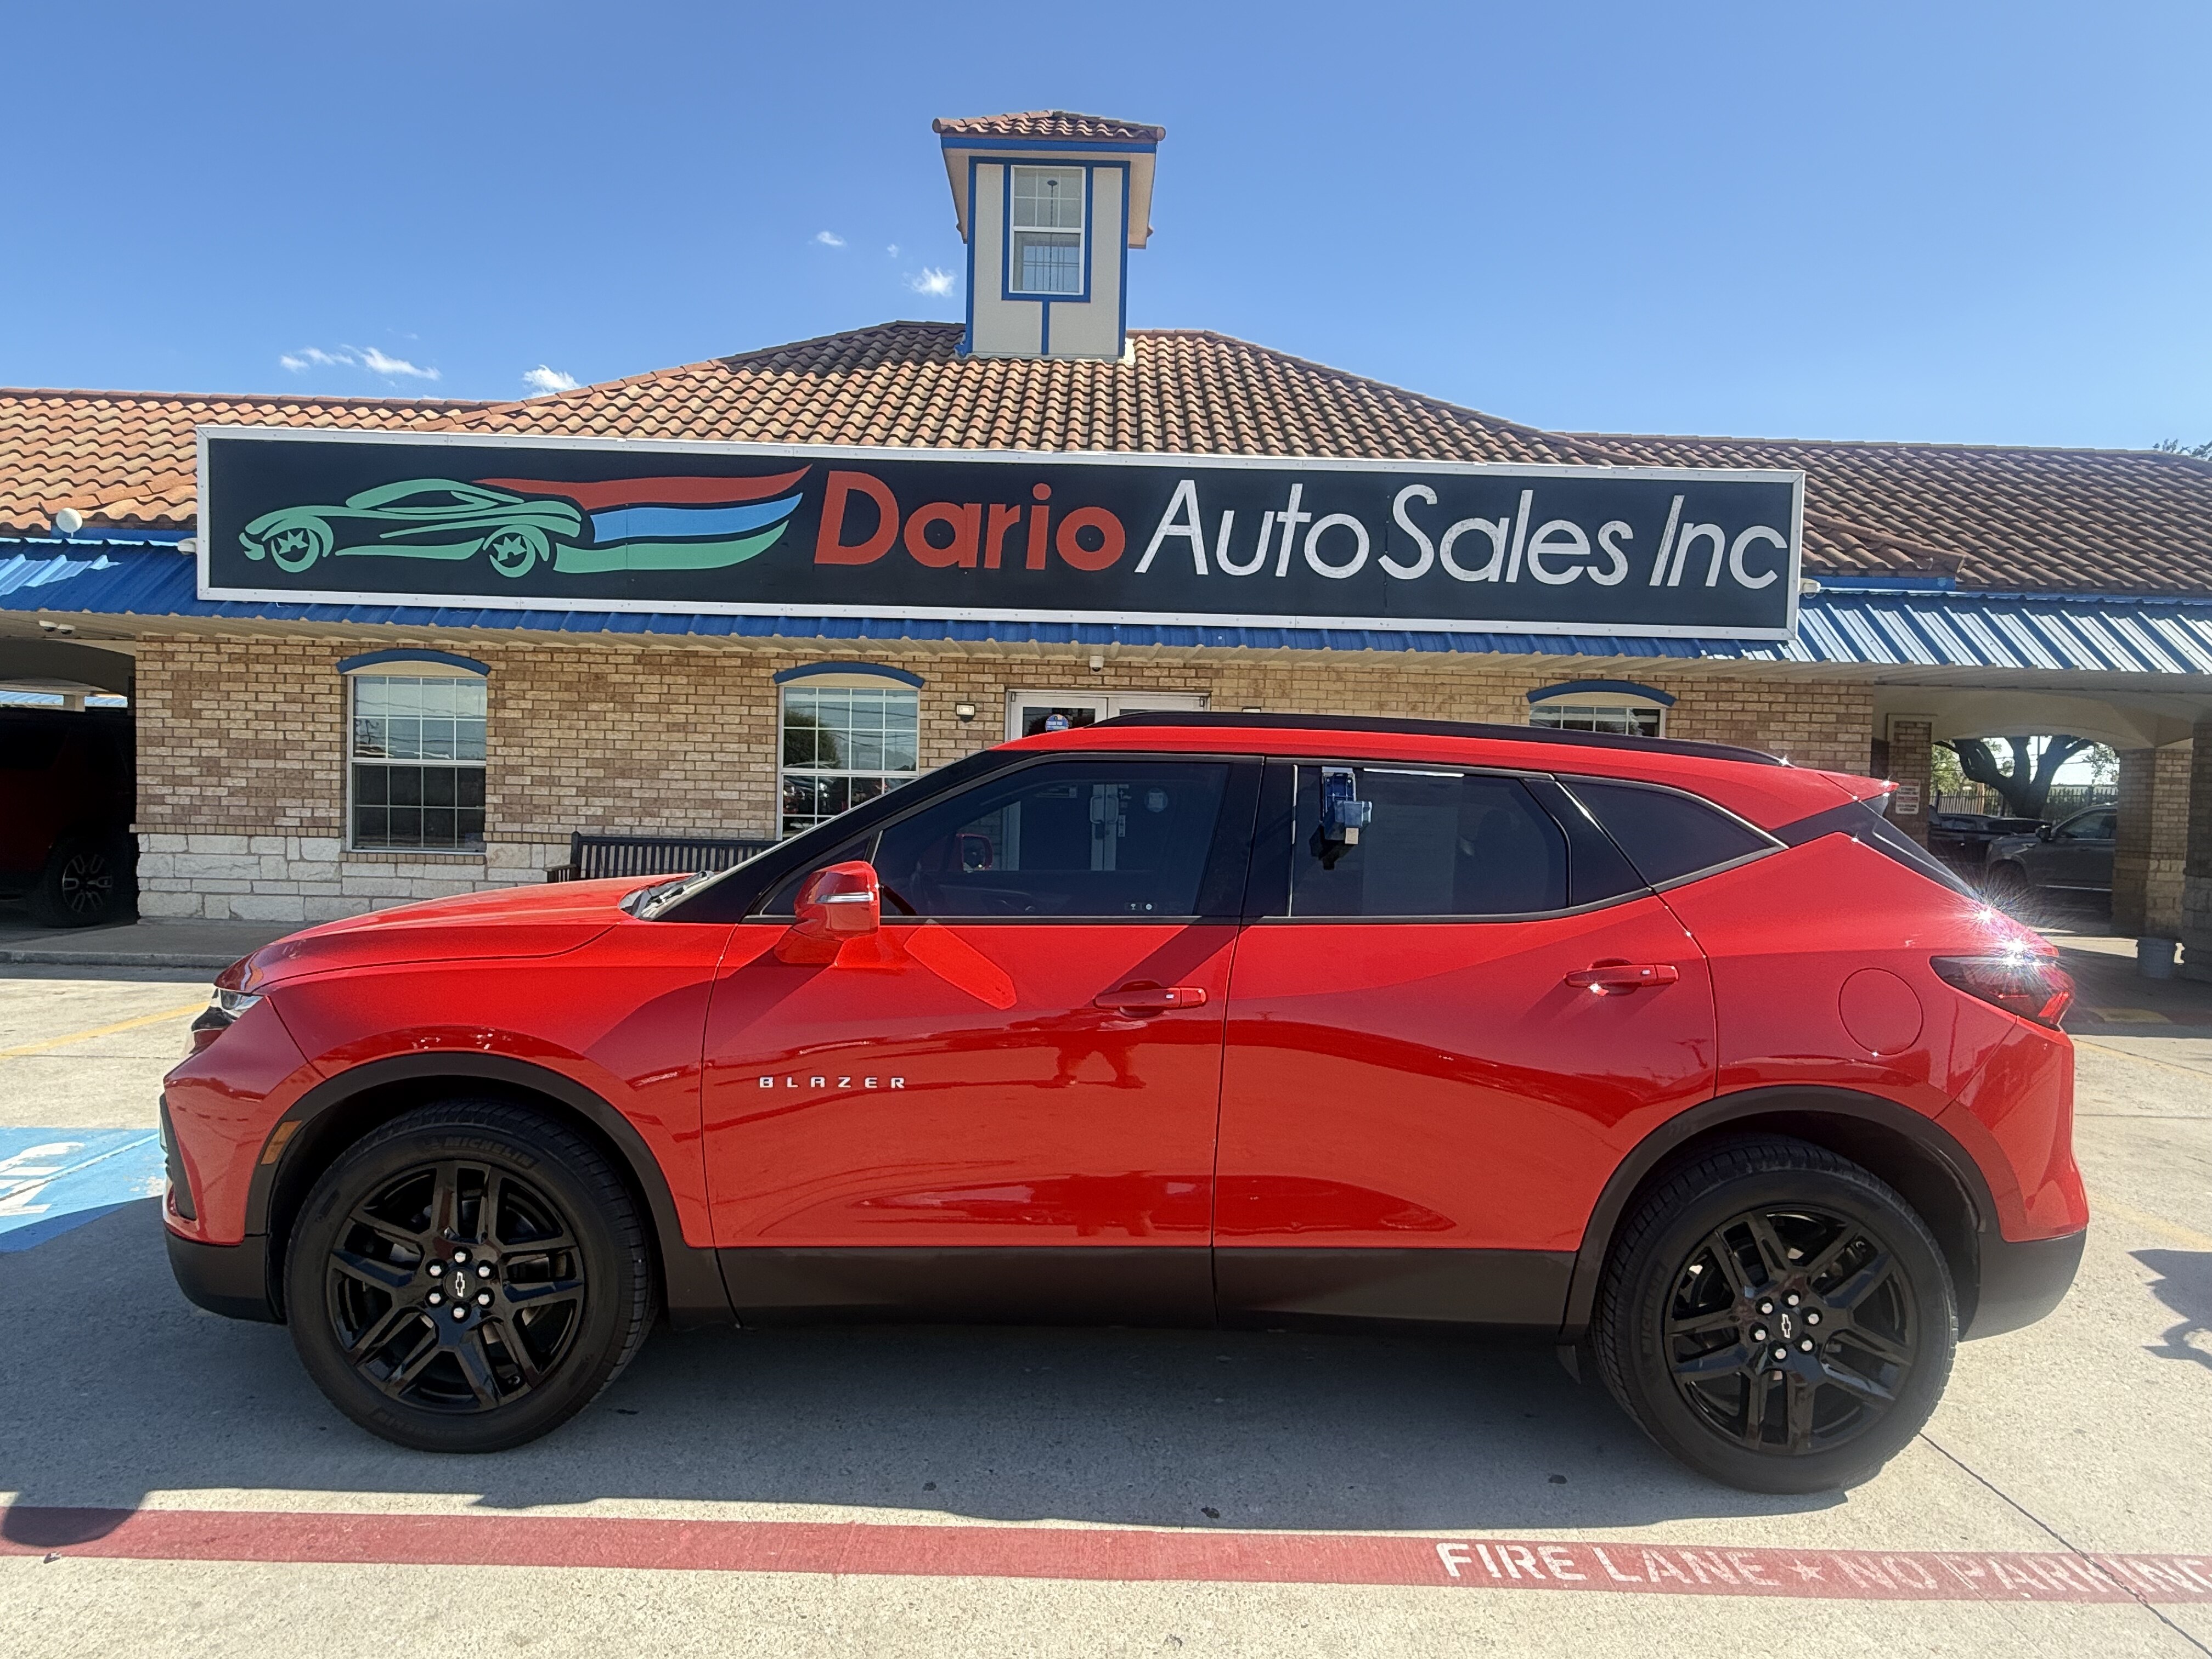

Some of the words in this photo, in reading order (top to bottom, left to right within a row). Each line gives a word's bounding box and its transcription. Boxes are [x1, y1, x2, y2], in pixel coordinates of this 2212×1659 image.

[814, 470, 1126, 571] Dario
[1135, 479, 1370, 579] Auto
[1378, 484, 1634, 585] Sales
[1649, 495, 1787, 589] Inc
[759, 1076, 905, 1089] BLAZER
[443, 1136, 535, 1167] MICHELIN
[1435, 1542, 1587, 1581] FIRE
[1592, 1547, 1781, 1586] LANE
[1827, 1553, 1939, 1590] NO
